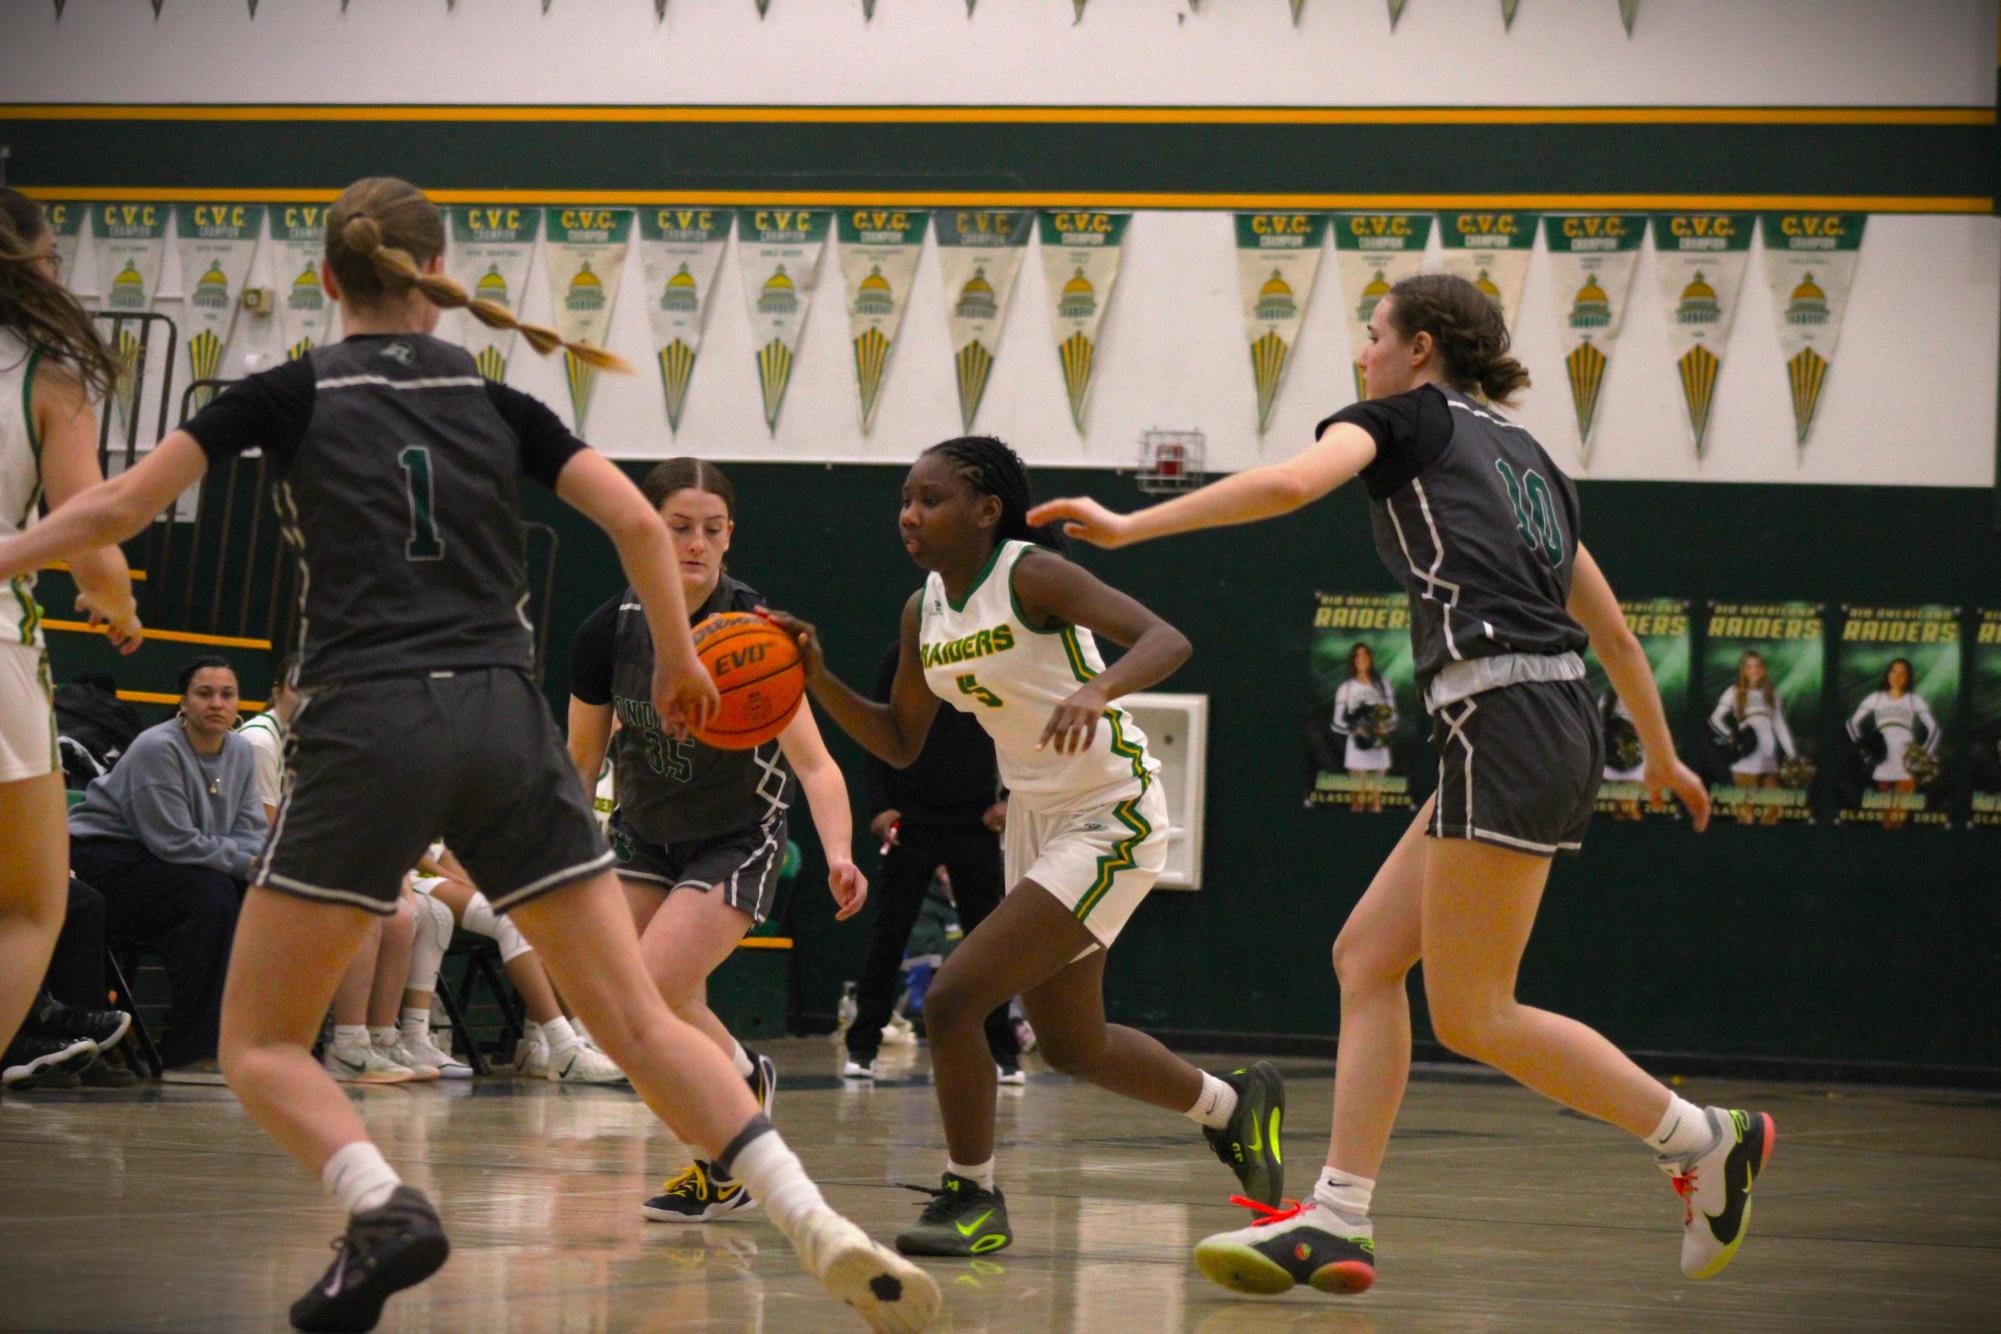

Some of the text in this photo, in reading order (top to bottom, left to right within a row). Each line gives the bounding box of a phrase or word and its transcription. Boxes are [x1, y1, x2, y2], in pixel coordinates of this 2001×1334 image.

[561, 210, 616, 230] C.V.C.
[853, 210, 911, 231] C.V.C.
[1055, 212, 1112, 232] C.V.C.
[1252, 215, 1312, 234] C.V.C.
[1350, 215, 1413, 236] C.V.C.
[1457, 215, 1519, 235] C.V.C.
[1563, 216, 1626, 237] C.V.C.
[1670, 216, 1735, 236] C.V.C.
[1781, 216, 1844, 235] C.V.C.
[398, 444, 446, 561] 1
[1495, 458, 1564, 569] 10
[1708, 616, 1822, 640] RAIDERS
[1843, 620, 1958, 643] RAIDERS
[920, 624, 1015, 669] RAIDERS
[956, 674, 1004, 708] 5
[643, 729, 695, 783] 35
